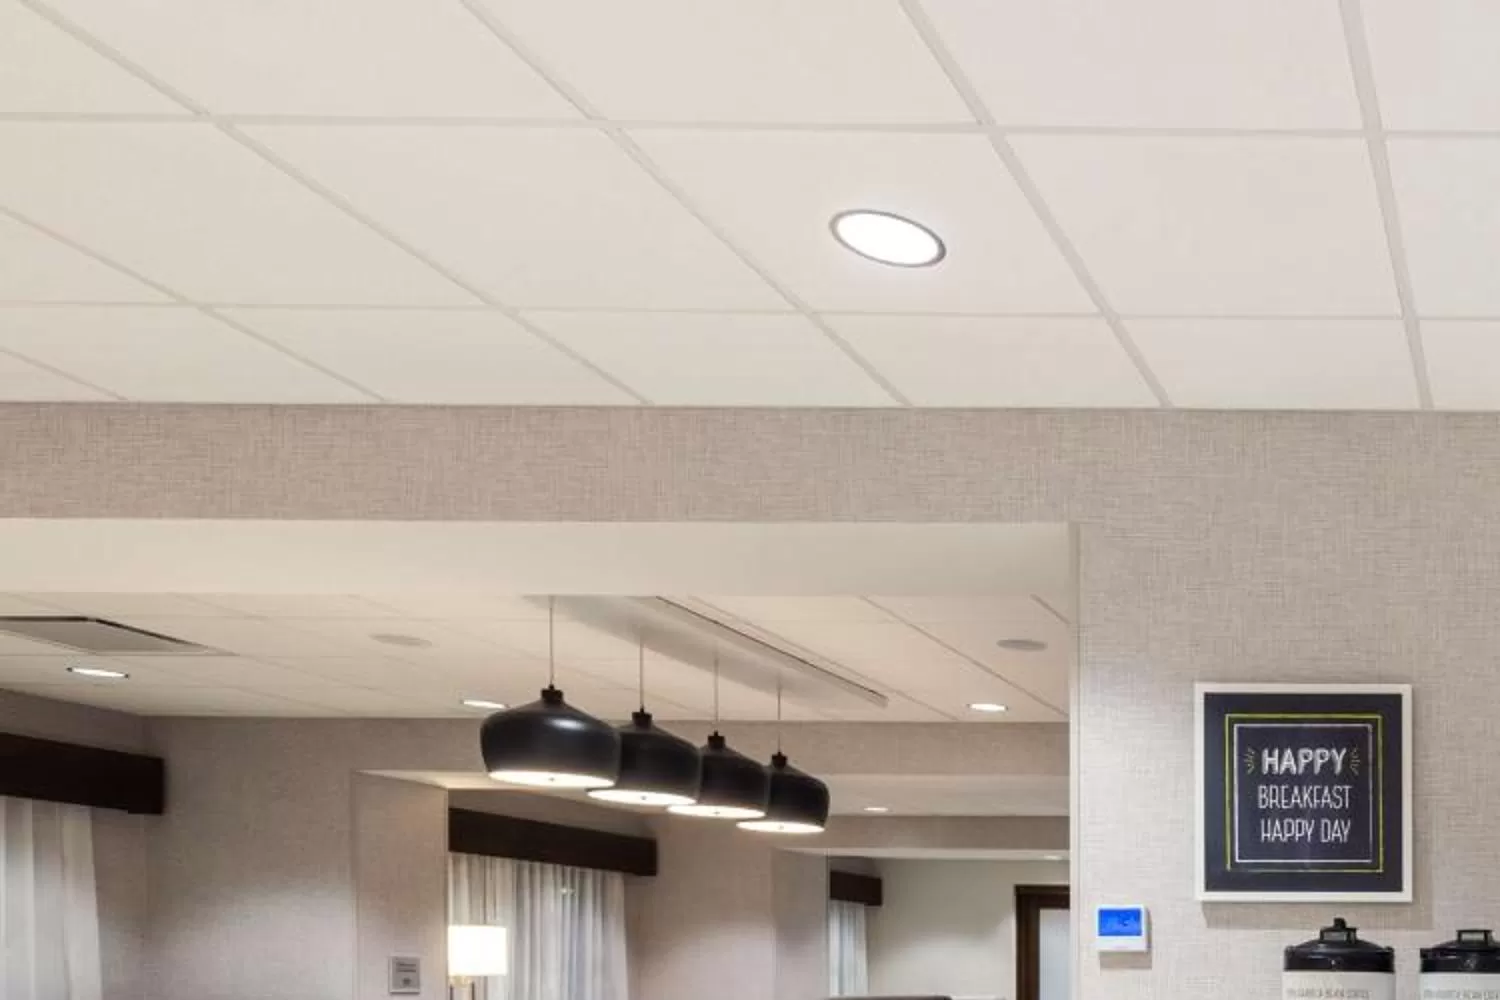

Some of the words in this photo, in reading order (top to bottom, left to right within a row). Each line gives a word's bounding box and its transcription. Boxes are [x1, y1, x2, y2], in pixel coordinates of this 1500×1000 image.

[1261, 747, 1347, 776] HAPPY
[1257, 784, 1353, 810] BREAKFAST
[1260, 818, 1315, 843] HAPPY
[1320, 818, 1351, 843] DAY
